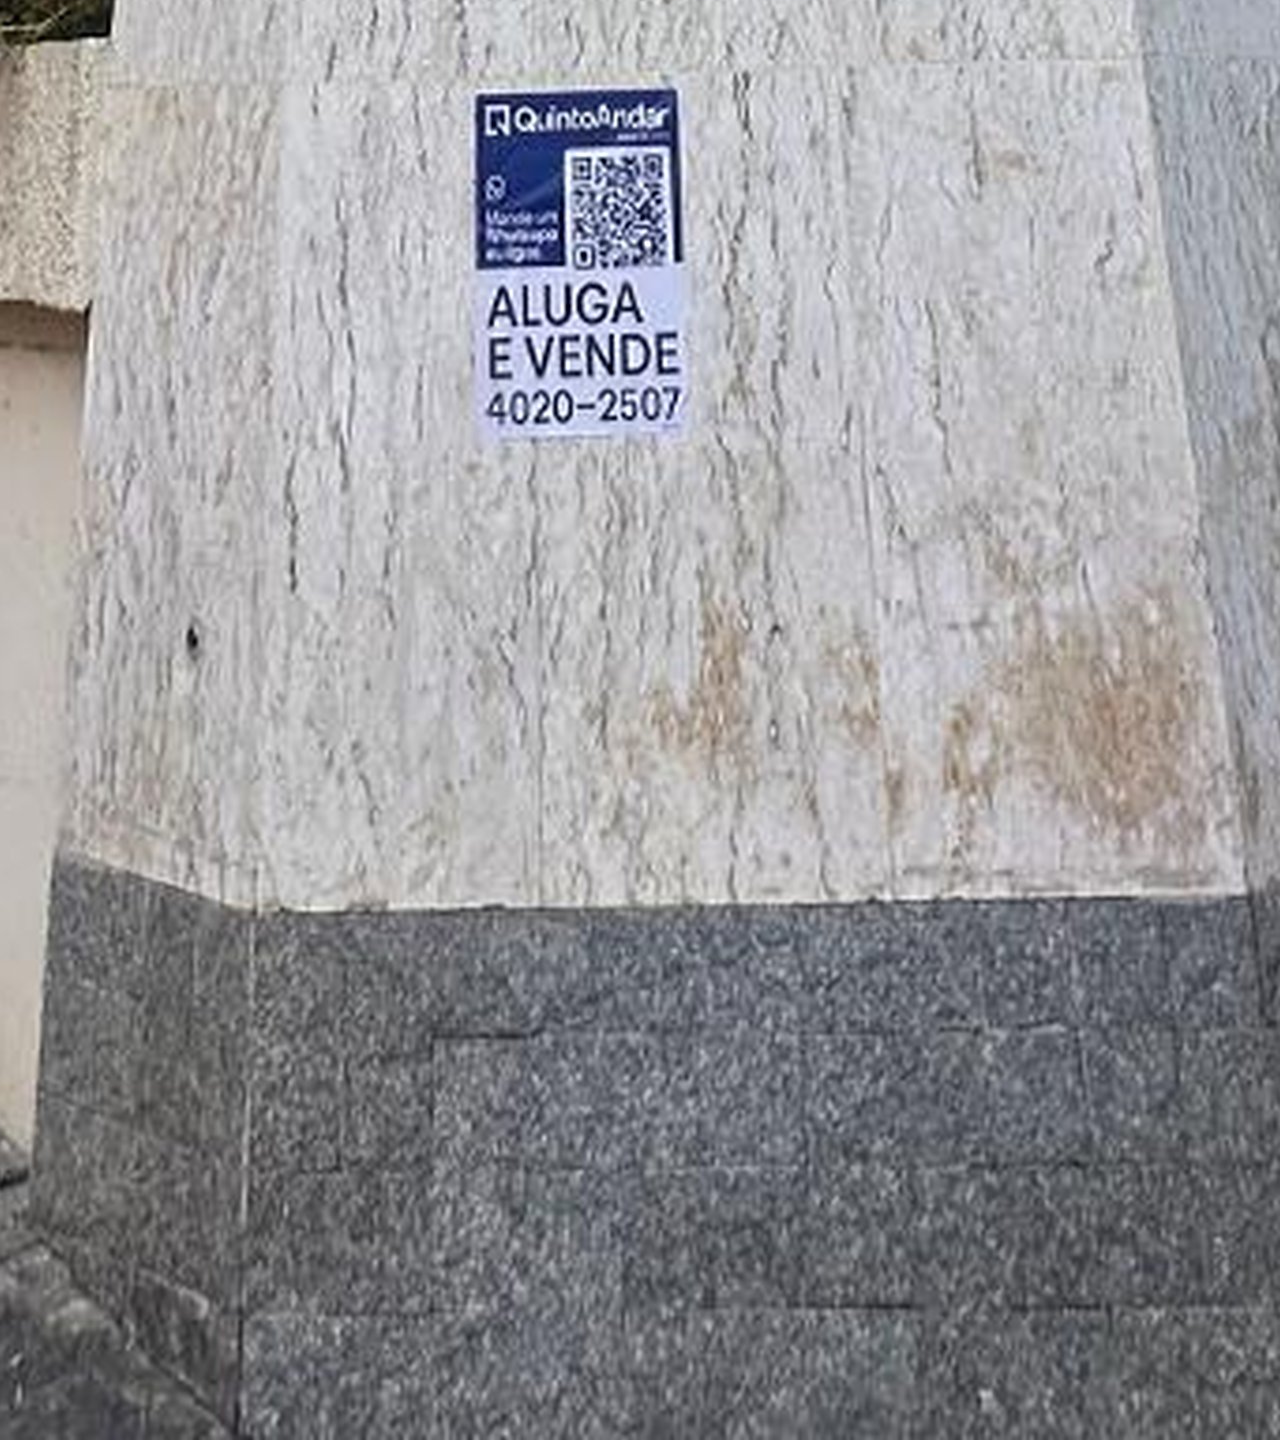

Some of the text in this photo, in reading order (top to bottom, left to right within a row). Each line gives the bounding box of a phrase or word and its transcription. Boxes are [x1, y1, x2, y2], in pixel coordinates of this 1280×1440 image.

[514, 102, 670, 132] QuintoAndar
[488, 282, 644, 328] ALUGA
[489, 332, 681, 379] E VENDE
[486, 387, 681, 426] 4020-2507
